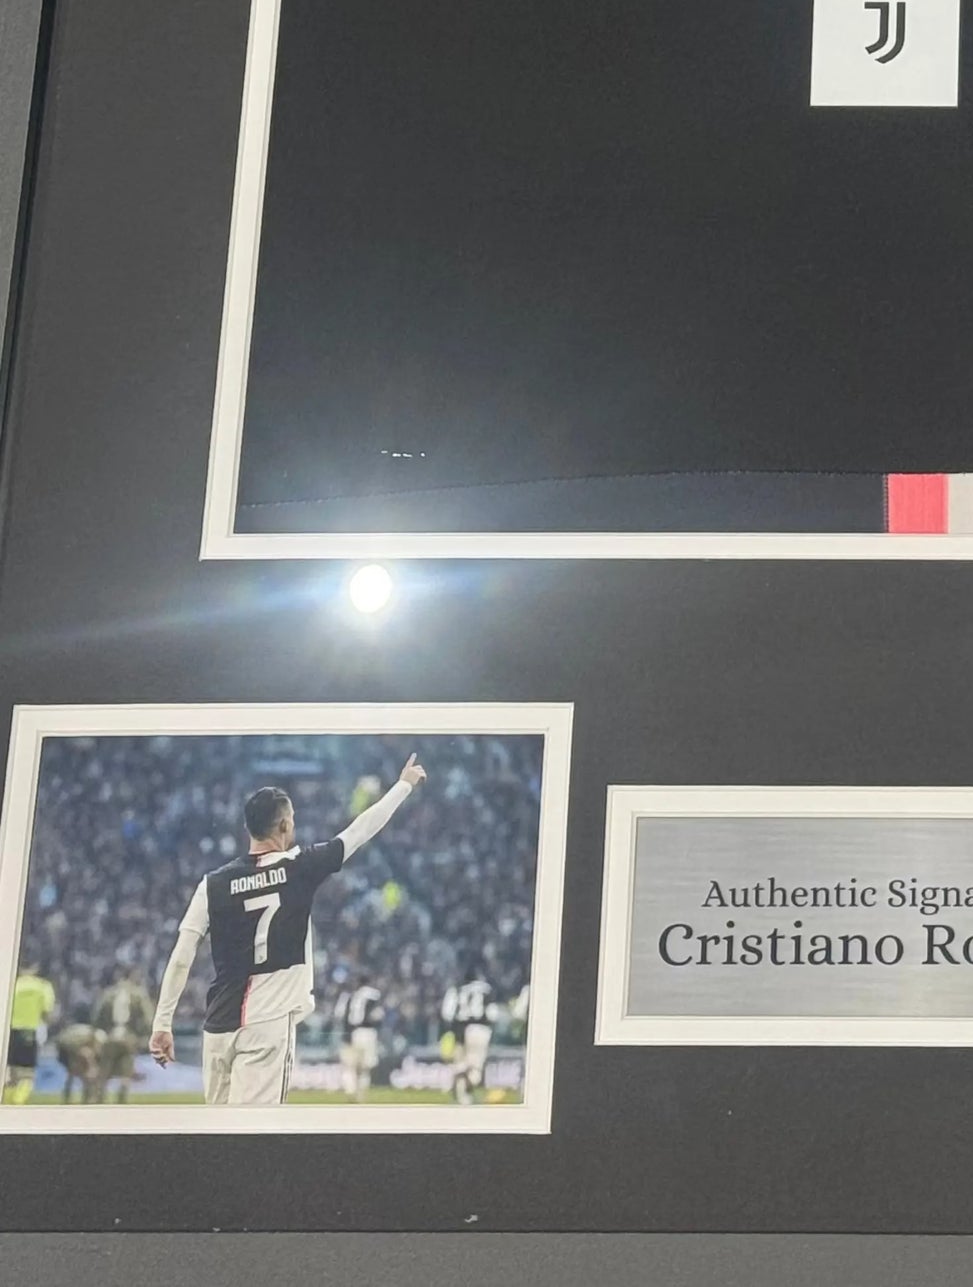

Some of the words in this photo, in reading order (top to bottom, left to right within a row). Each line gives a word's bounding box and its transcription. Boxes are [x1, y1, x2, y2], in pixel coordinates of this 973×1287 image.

[230, 866, 287, 895] RONALDO
[701, 877, 877, 908] Authentic
[243, 892, 282, 965] 7
[658, 920, 904, 966] Cristiano
